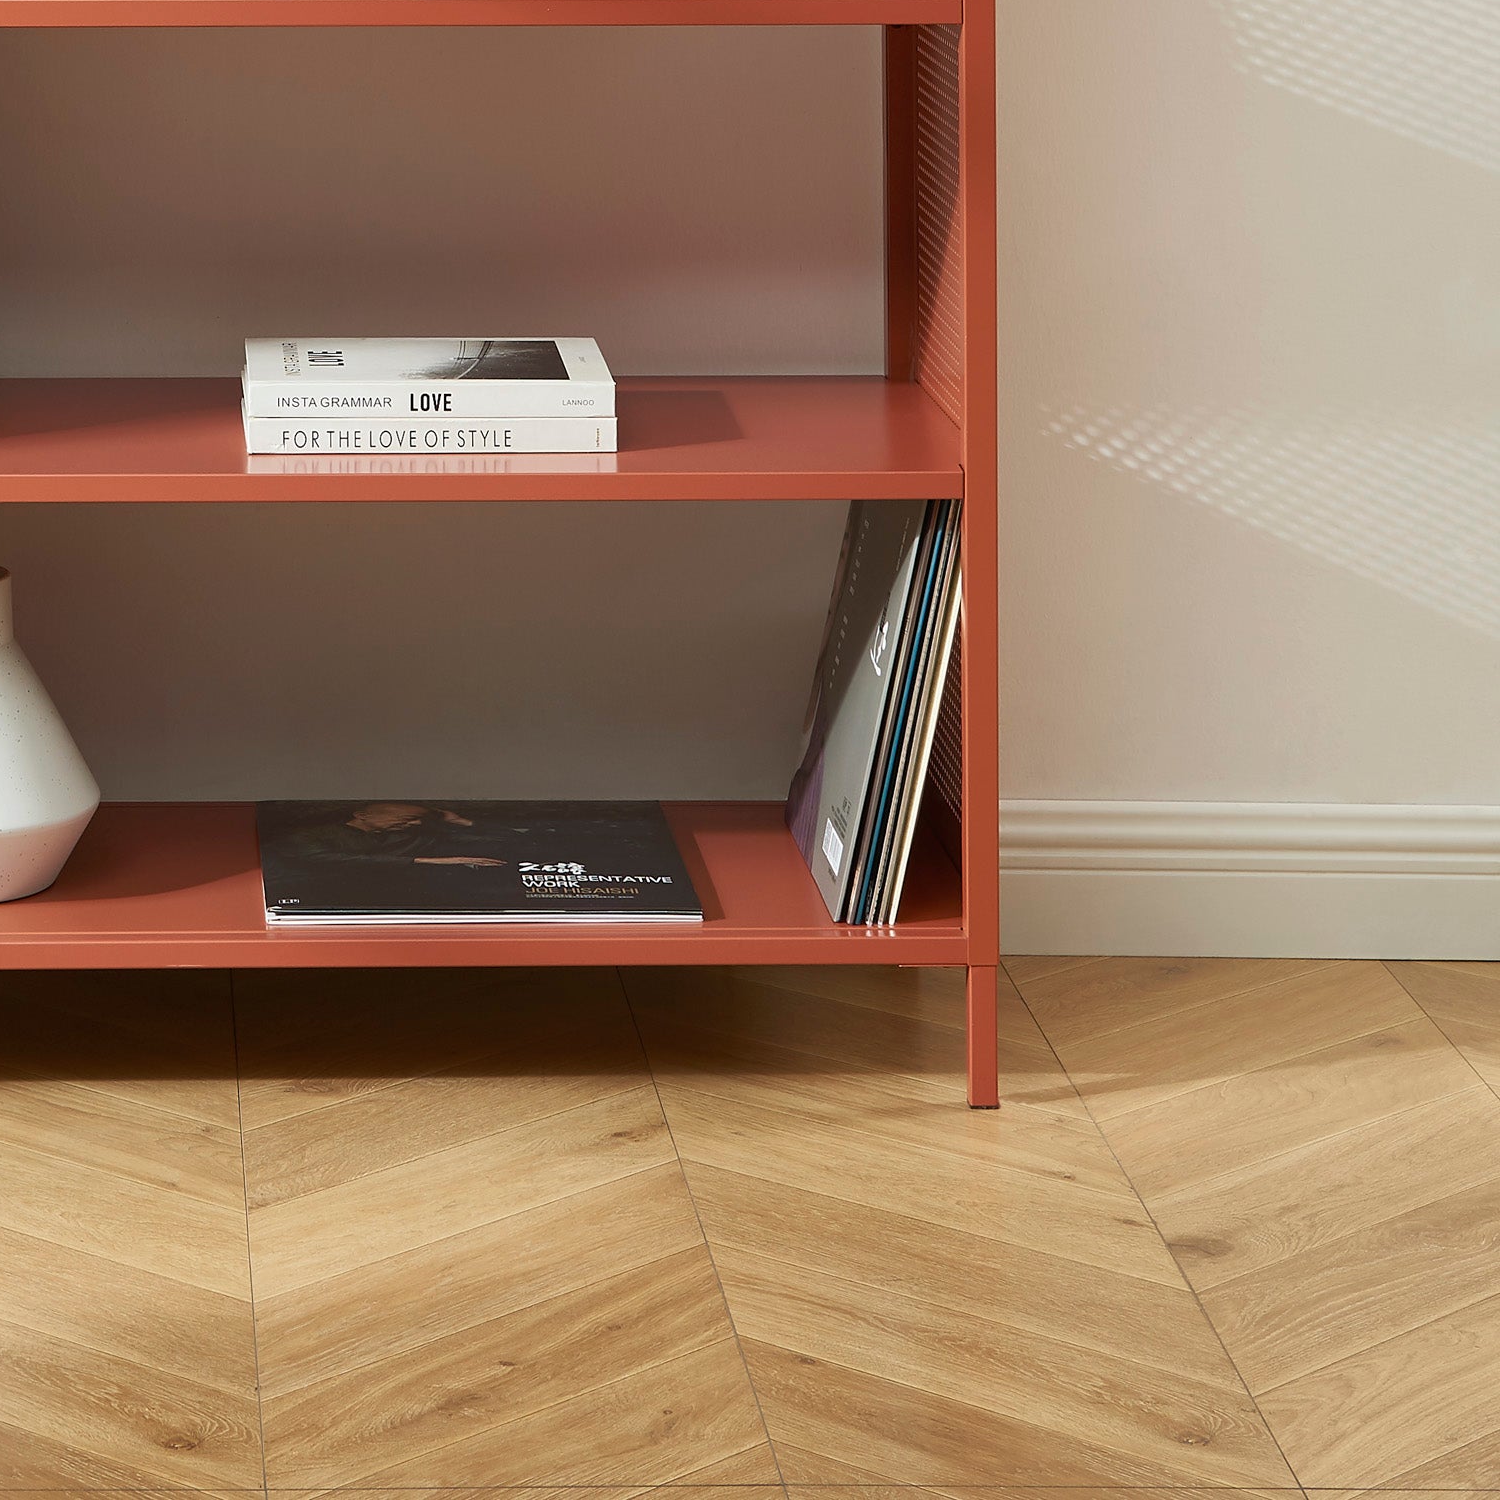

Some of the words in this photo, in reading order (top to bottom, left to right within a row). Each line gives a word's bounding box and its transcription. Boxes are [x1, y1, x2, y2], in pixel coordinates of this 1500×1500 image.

[409, 393, 452, 412] LOVE
[281, 430, 320, 449] FOR
[326, 430, 362, 448] THE
[369, 430, 417, 448] LOVE
[424, 430, 452, 448] OF
[456, 430, 513, 448] STYLE
[521, 874, 674, 884] REPRESENTATIVE
[522, 880, 581, 888] WORK
